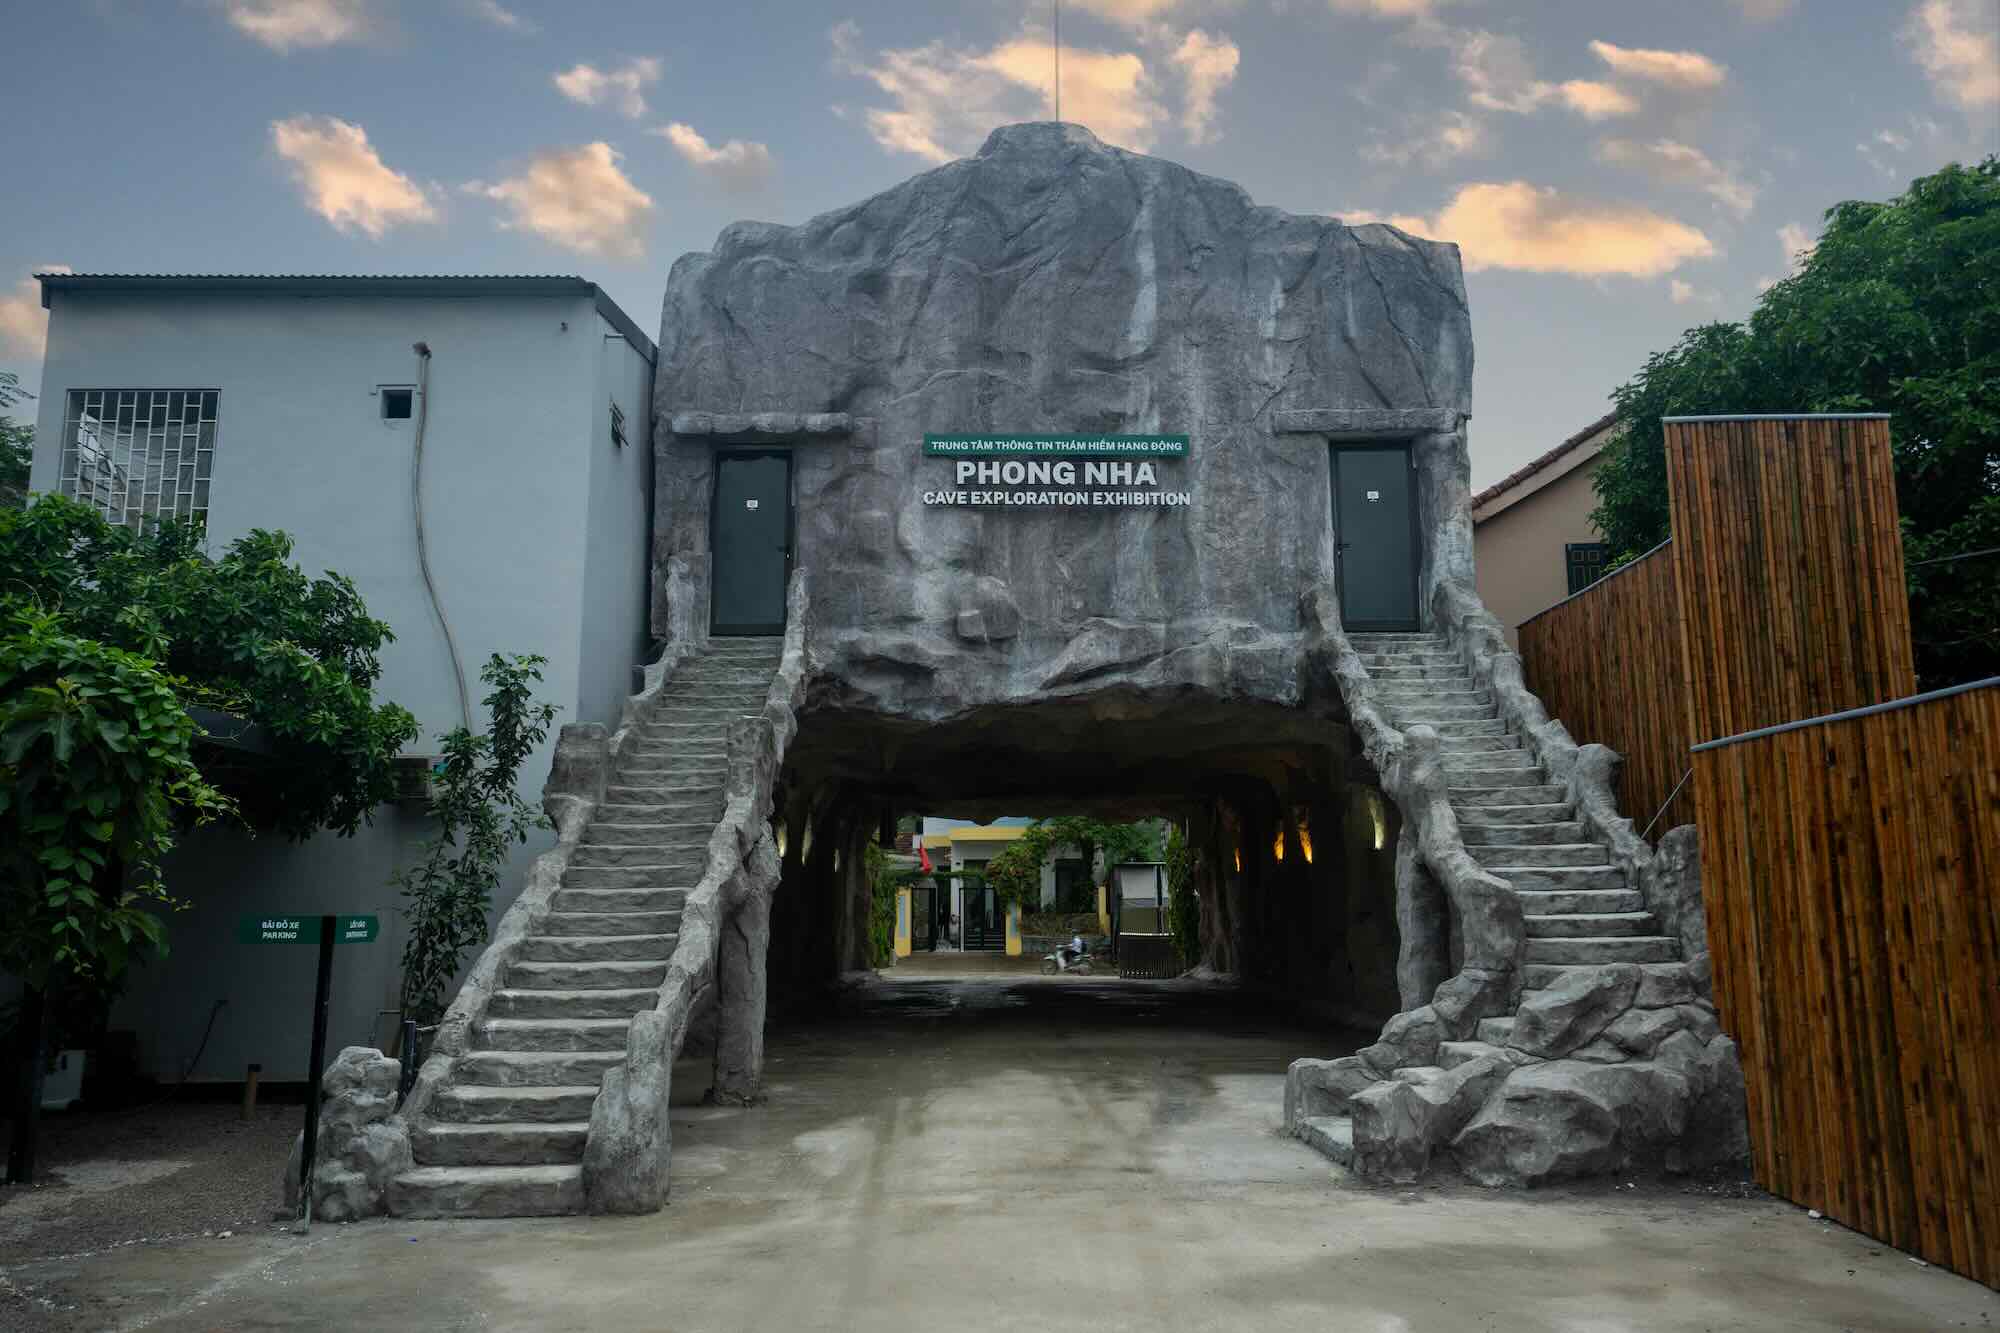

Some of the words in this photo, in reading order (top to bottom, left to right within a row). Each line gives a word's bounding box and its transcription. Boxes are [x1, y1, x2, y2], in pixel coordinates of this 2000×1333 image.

[931, 441, 968, 450] TRUNG
[970, 439, 994, 450] TÂM
[995, 439, 1033, 450] THÔNG
[1035, 441, 1053, 450] TIN
[1055, 439, 1086, 450] THÁM
[1117, 441, 1149, 450] HANG
[1150, 440, 1183, 452] ĐỘNG
[956, 461, 1075, 485] PHONG
[1084, 461, 1158, 485] NHA
[923, 491, 968, 505] CAVE
[971, 491, 1090, 505] EXPLORATION
[1093, 491, 1191, 505] EXHIBITION
[289, 921, 300, 929] XE
[263, 931, 297, 939] PARKING
